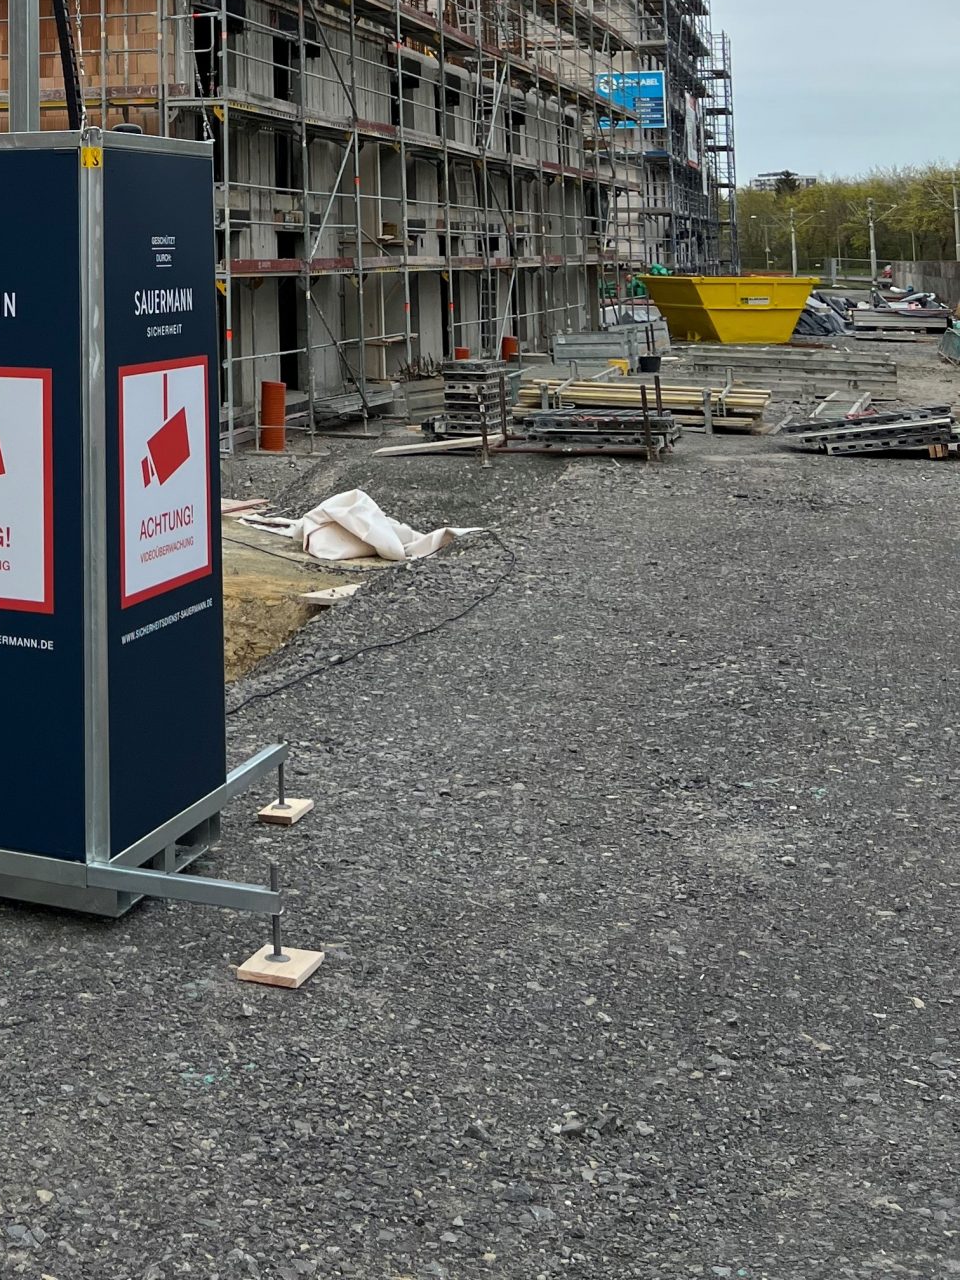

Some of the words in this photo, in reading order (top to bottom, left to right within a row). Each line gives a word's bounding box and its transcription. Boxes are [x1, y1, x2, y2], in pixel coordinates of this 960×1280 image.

[151, 235, 176, 245] GESCHÜTZT
[156, 254, 172, 263] DURCH:
[134, 287, 193, 316] SAUERMANN
[146, 324, 182, 337] SICHERHEIT
[139, 505, 194, 541] ACHTUNG!
[140, 536, 194, 564] VIDEOÜBERWACHUNG
[121, 597, 213, 645] WWW.SICHERHEITSDIENST-SAUERMANN.DE
